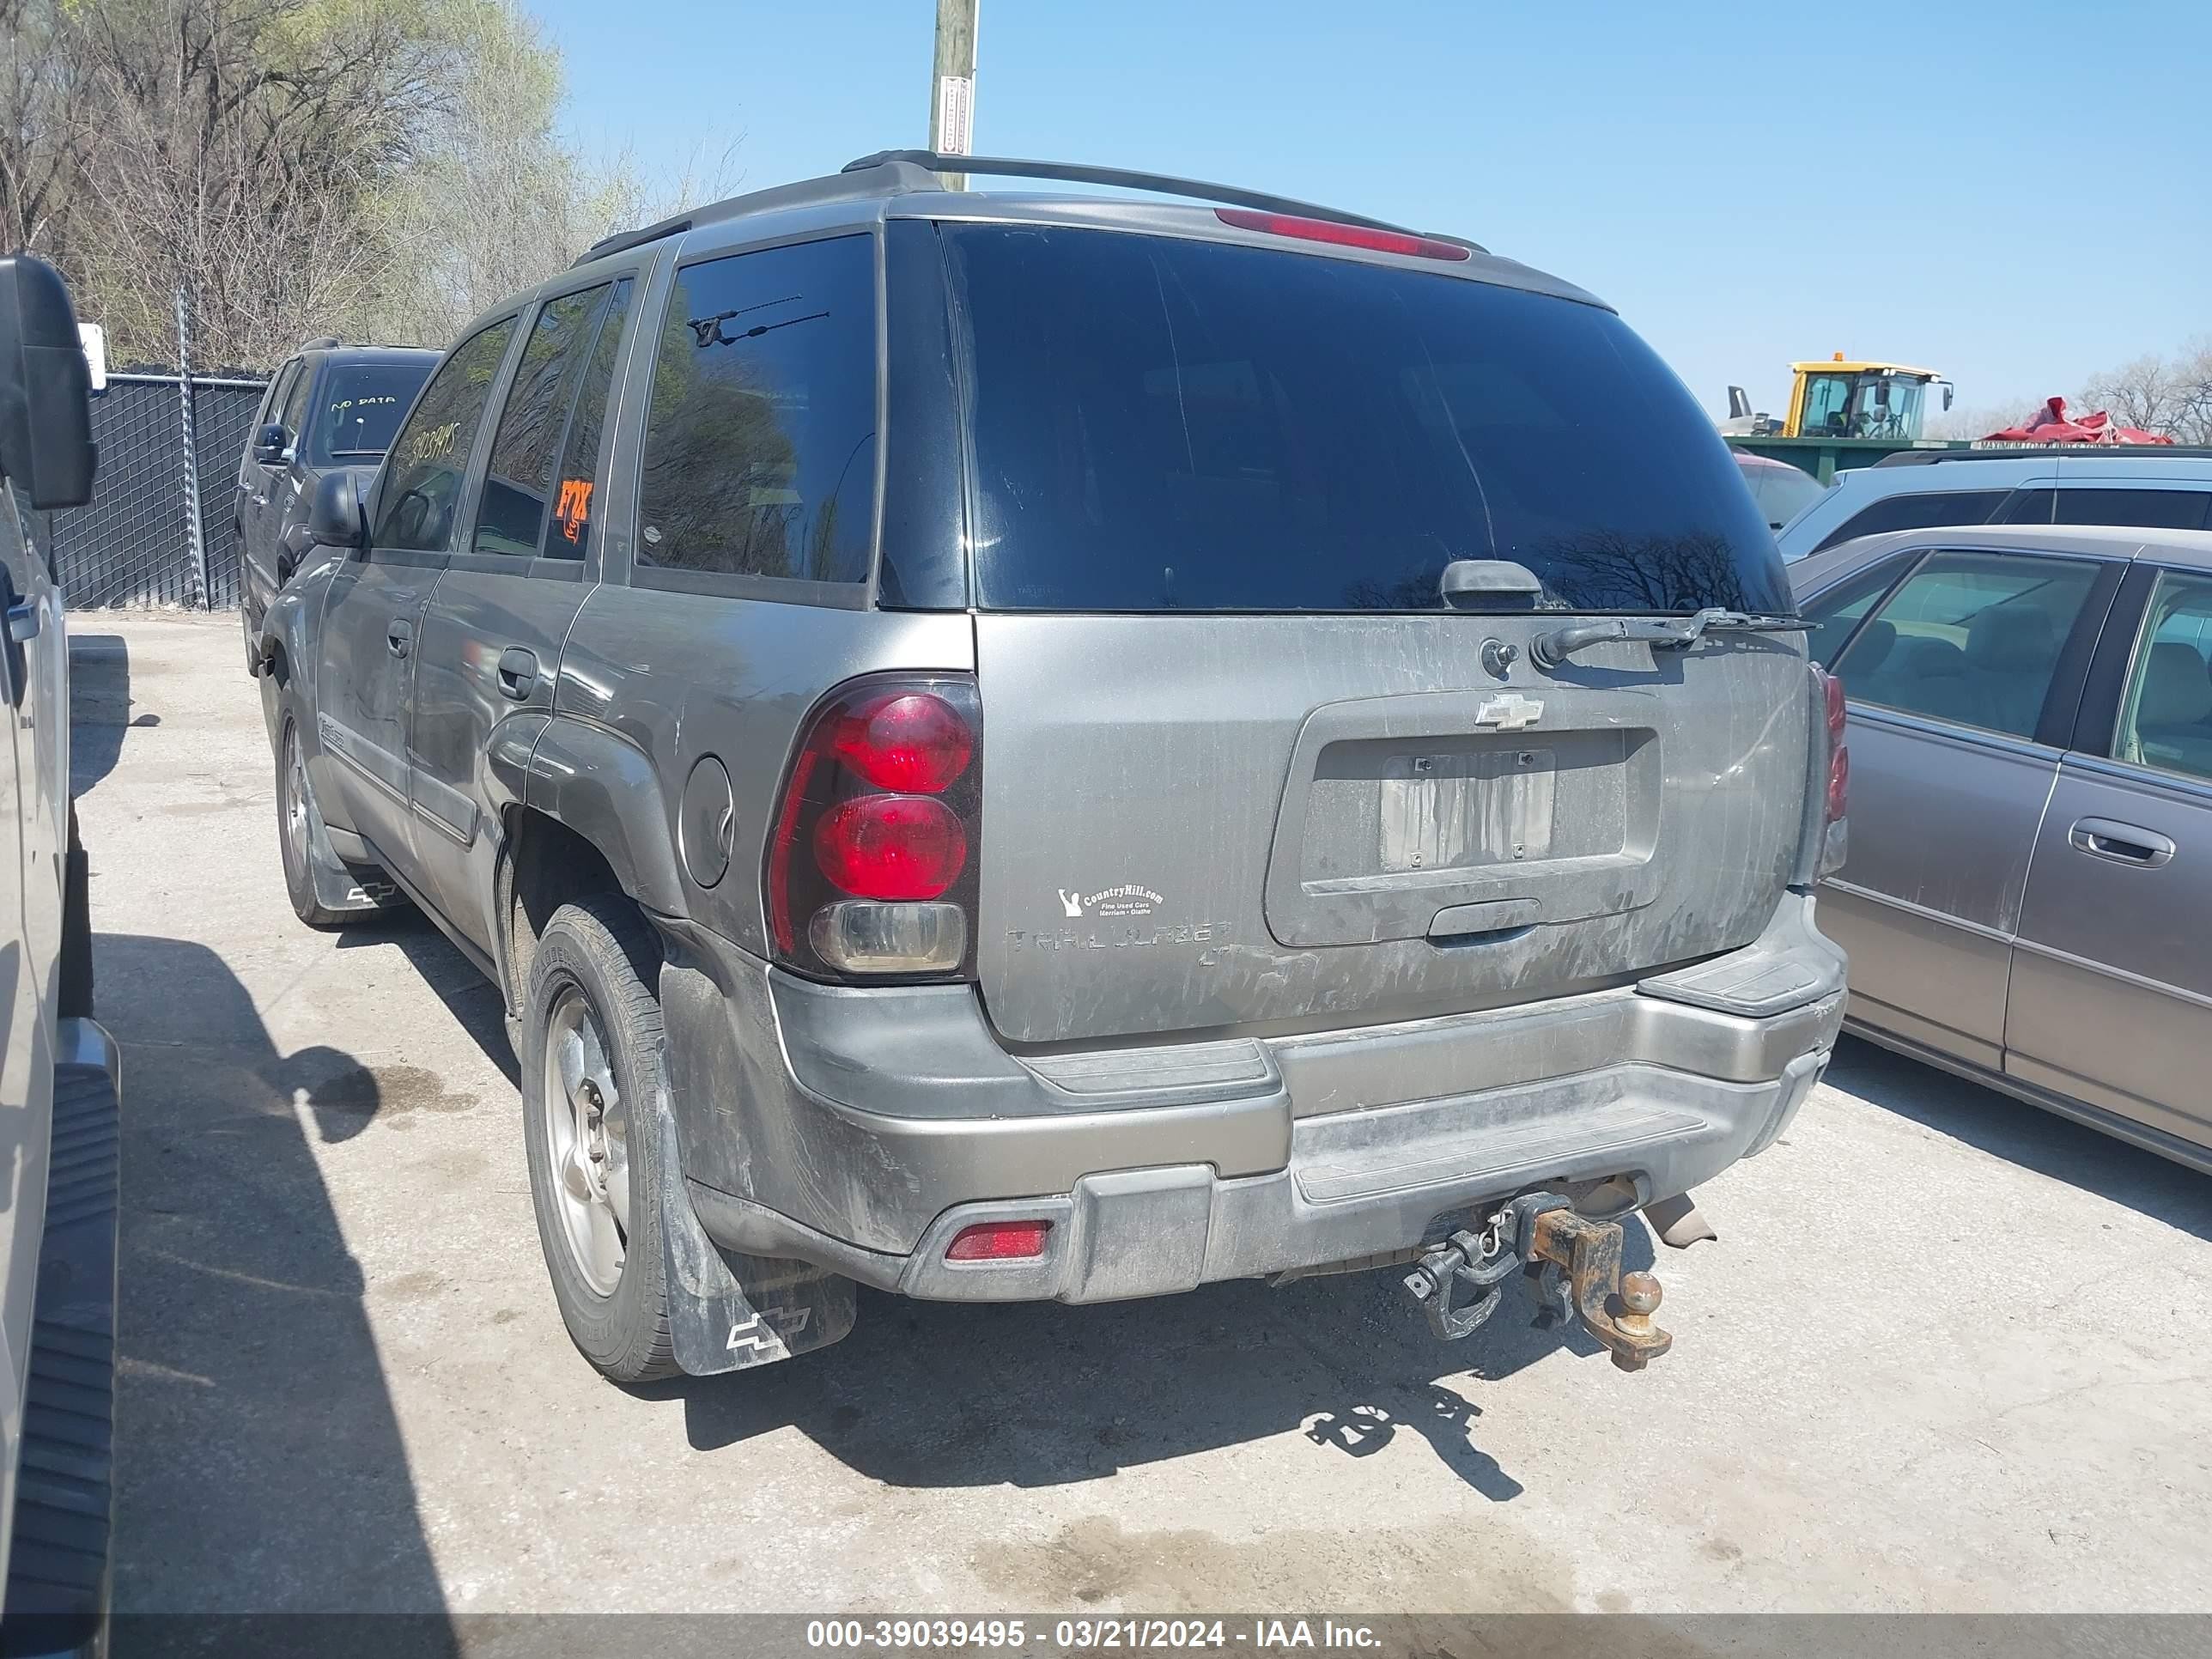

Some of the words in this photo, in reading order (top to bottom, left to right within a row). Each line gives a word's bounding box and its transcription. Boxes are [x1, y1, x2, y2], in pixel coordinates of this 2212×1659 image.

[331, 400, 352, 412] NO
[358, 397, 396, 405] DATA
[1084, 884, 1164, 907] CountryHill.com
